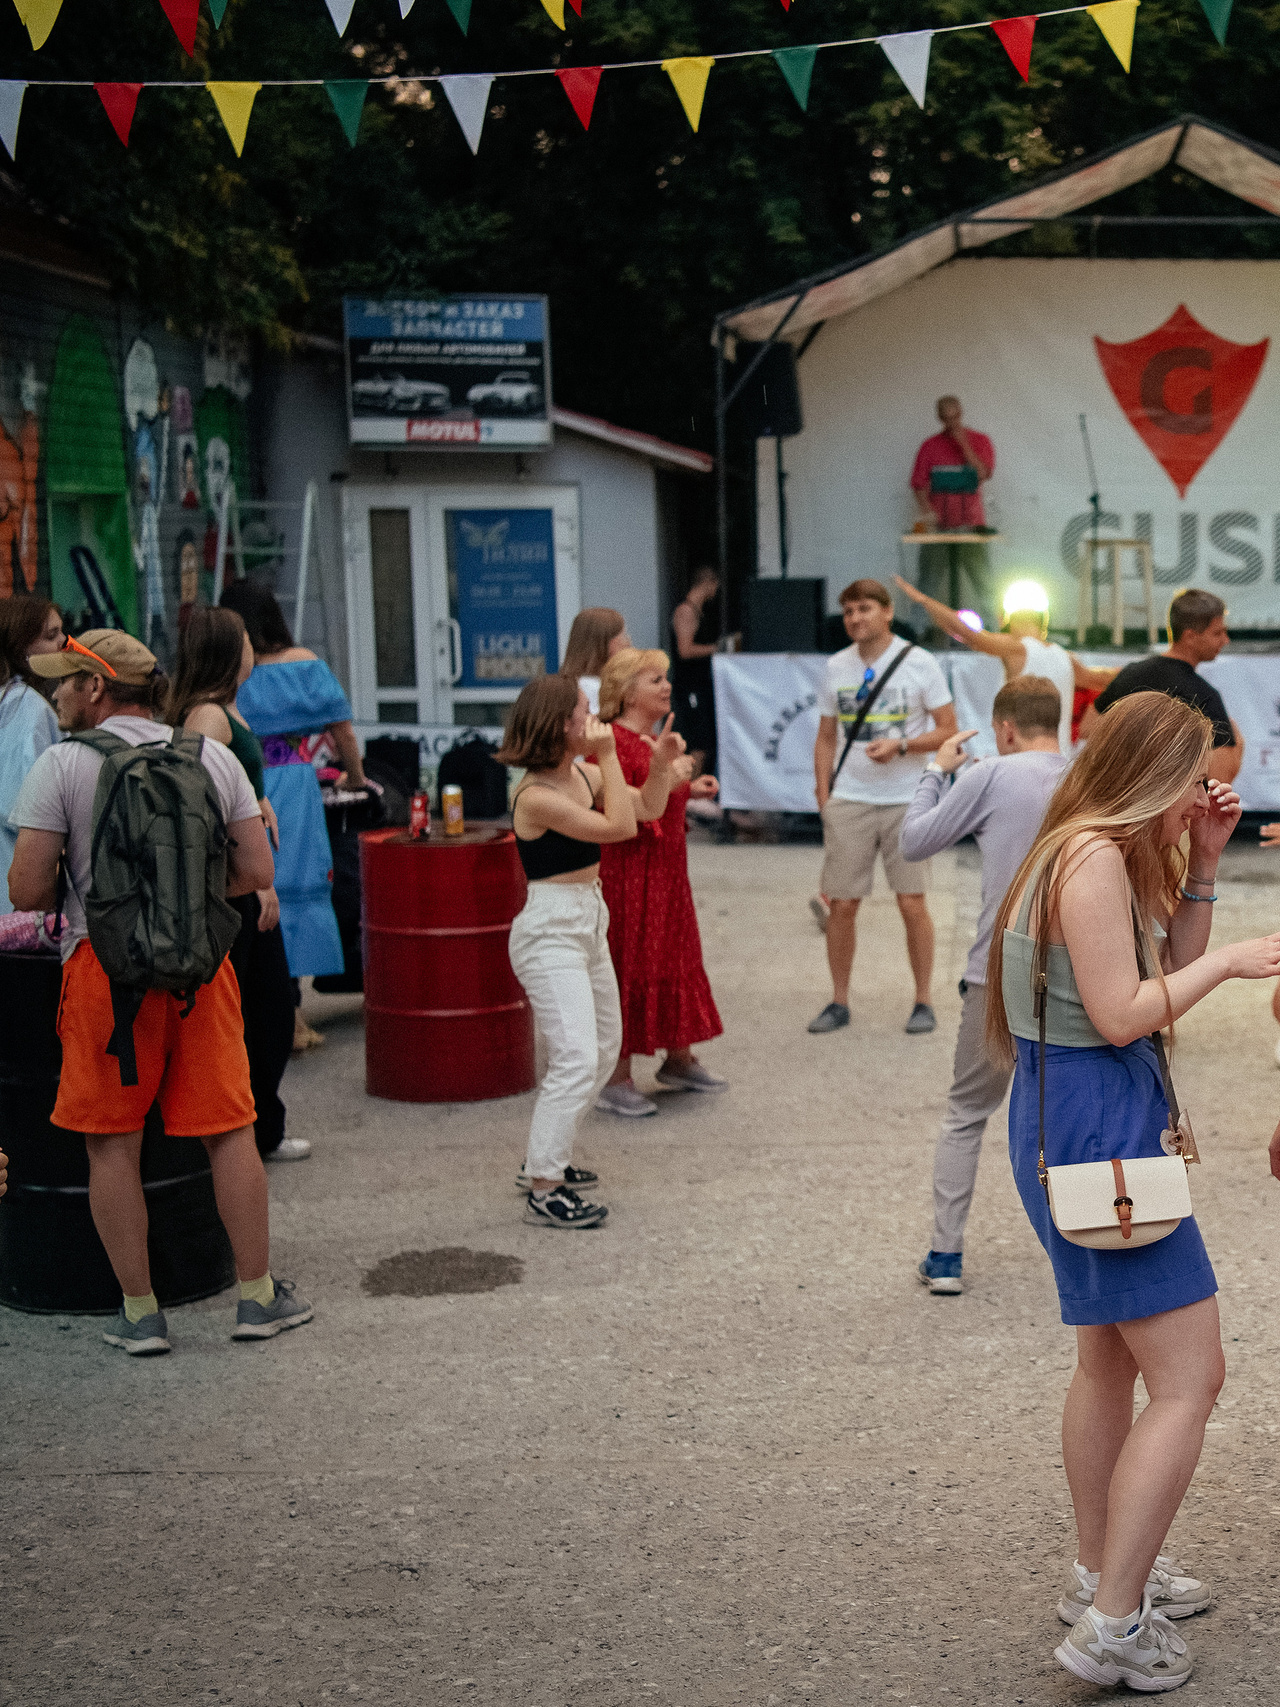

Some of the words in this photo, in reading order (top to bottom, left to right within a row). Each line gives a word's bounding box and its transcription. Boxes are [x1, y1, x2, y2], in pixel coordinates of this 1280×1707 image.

[462, 301, 525, 319] ЗАКАЗ
[1139, 345, 1213, 436] G
[411, 420, 477, 440] MOTUL
[478, 633, 541, 654] LIQUI
